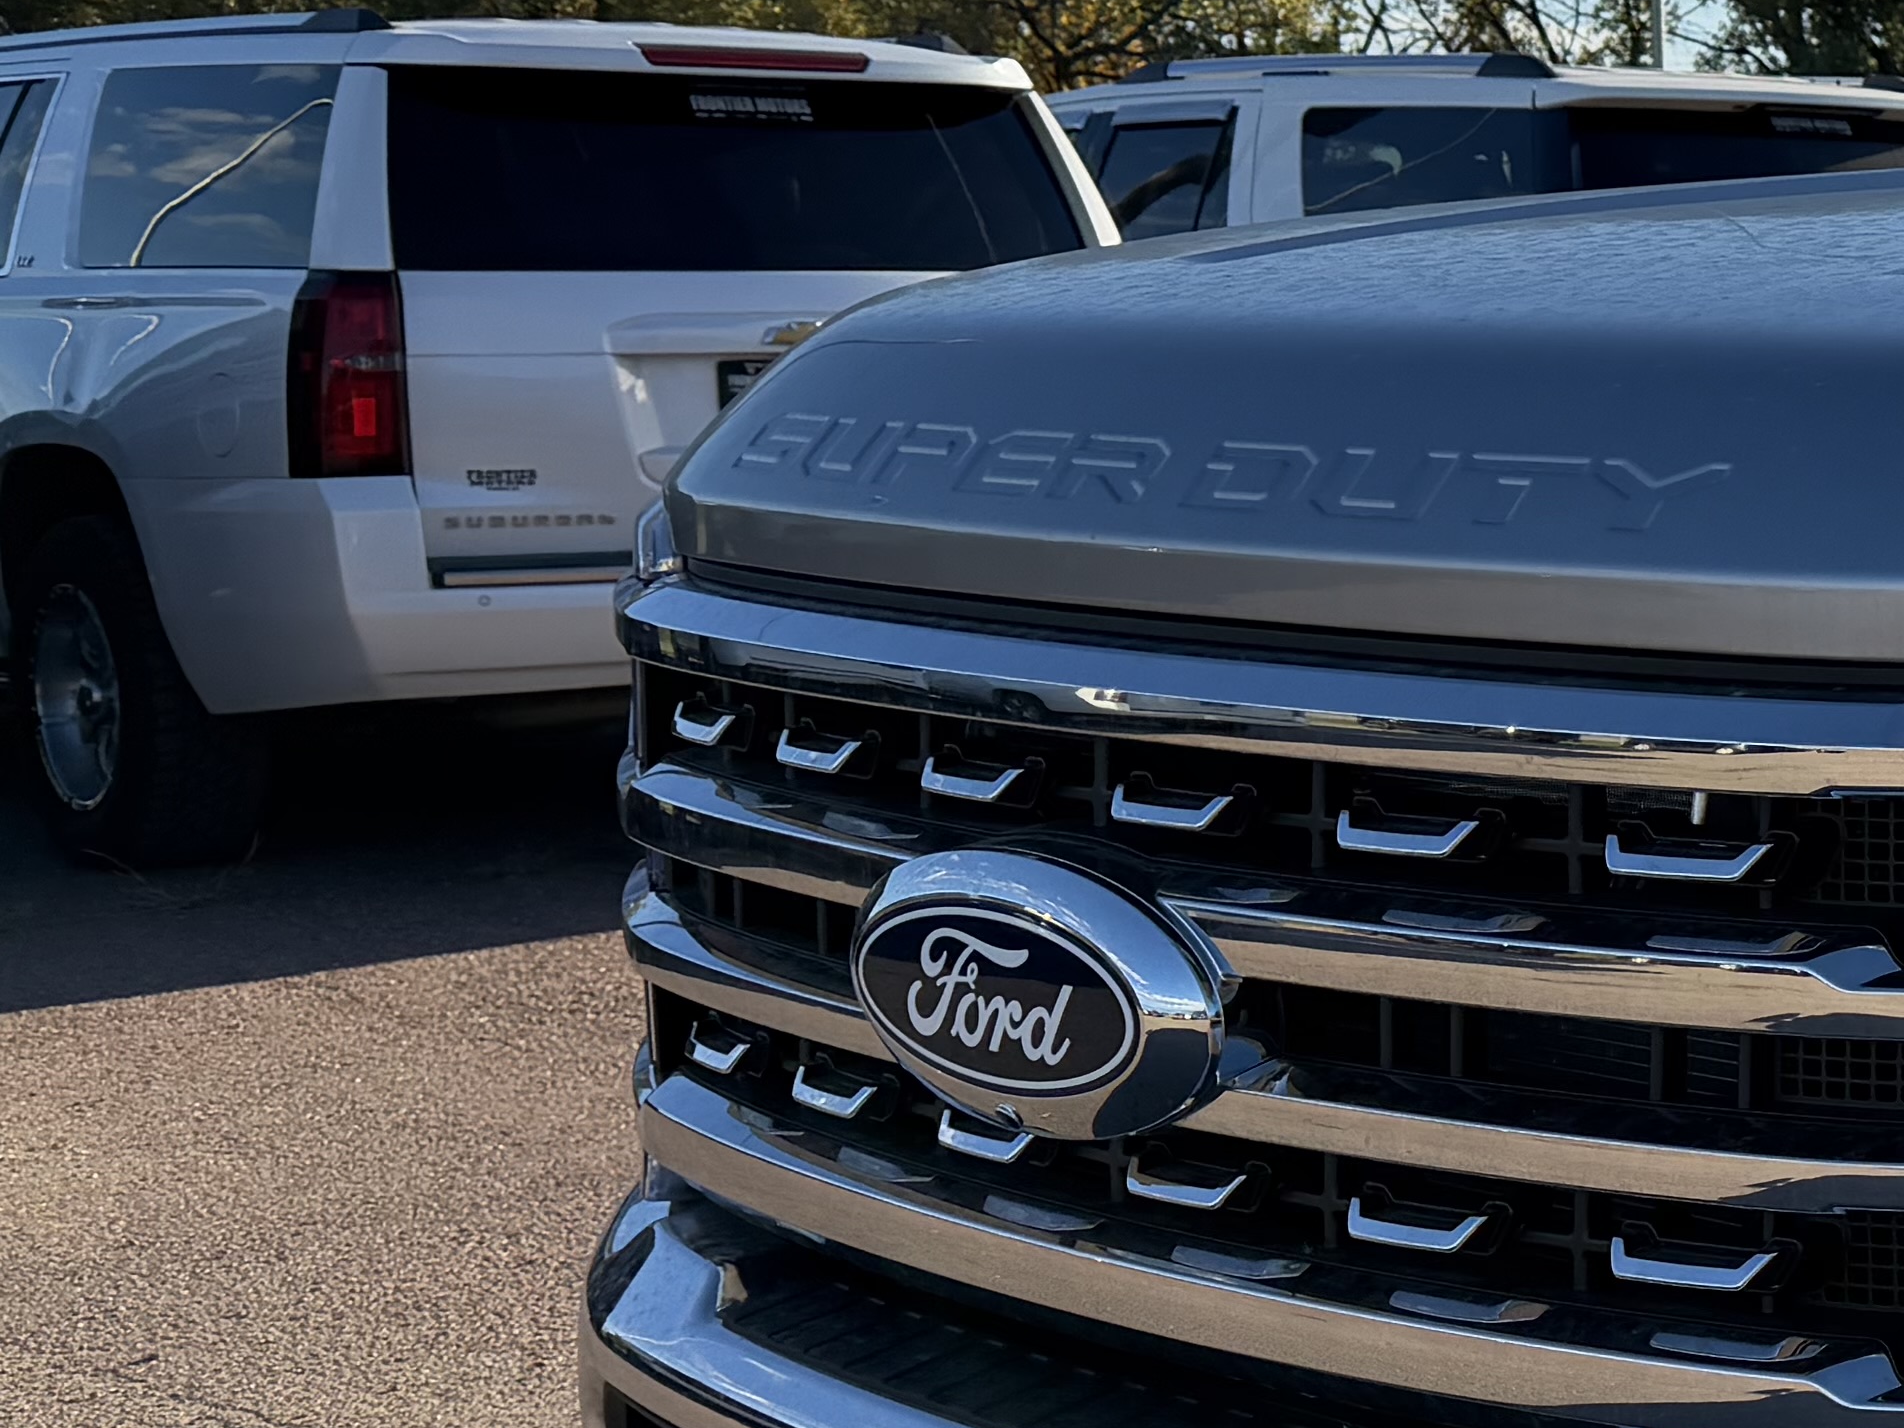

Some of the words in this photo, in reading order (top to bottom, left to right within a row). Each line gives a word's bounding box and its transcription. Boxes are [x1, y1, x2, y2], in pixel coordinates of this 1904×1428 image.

[731, 412, 1172, 506] SUPER
[1178, 439, 1736, 532] DUTY
[907, 927, 1074, 1066] Ford
